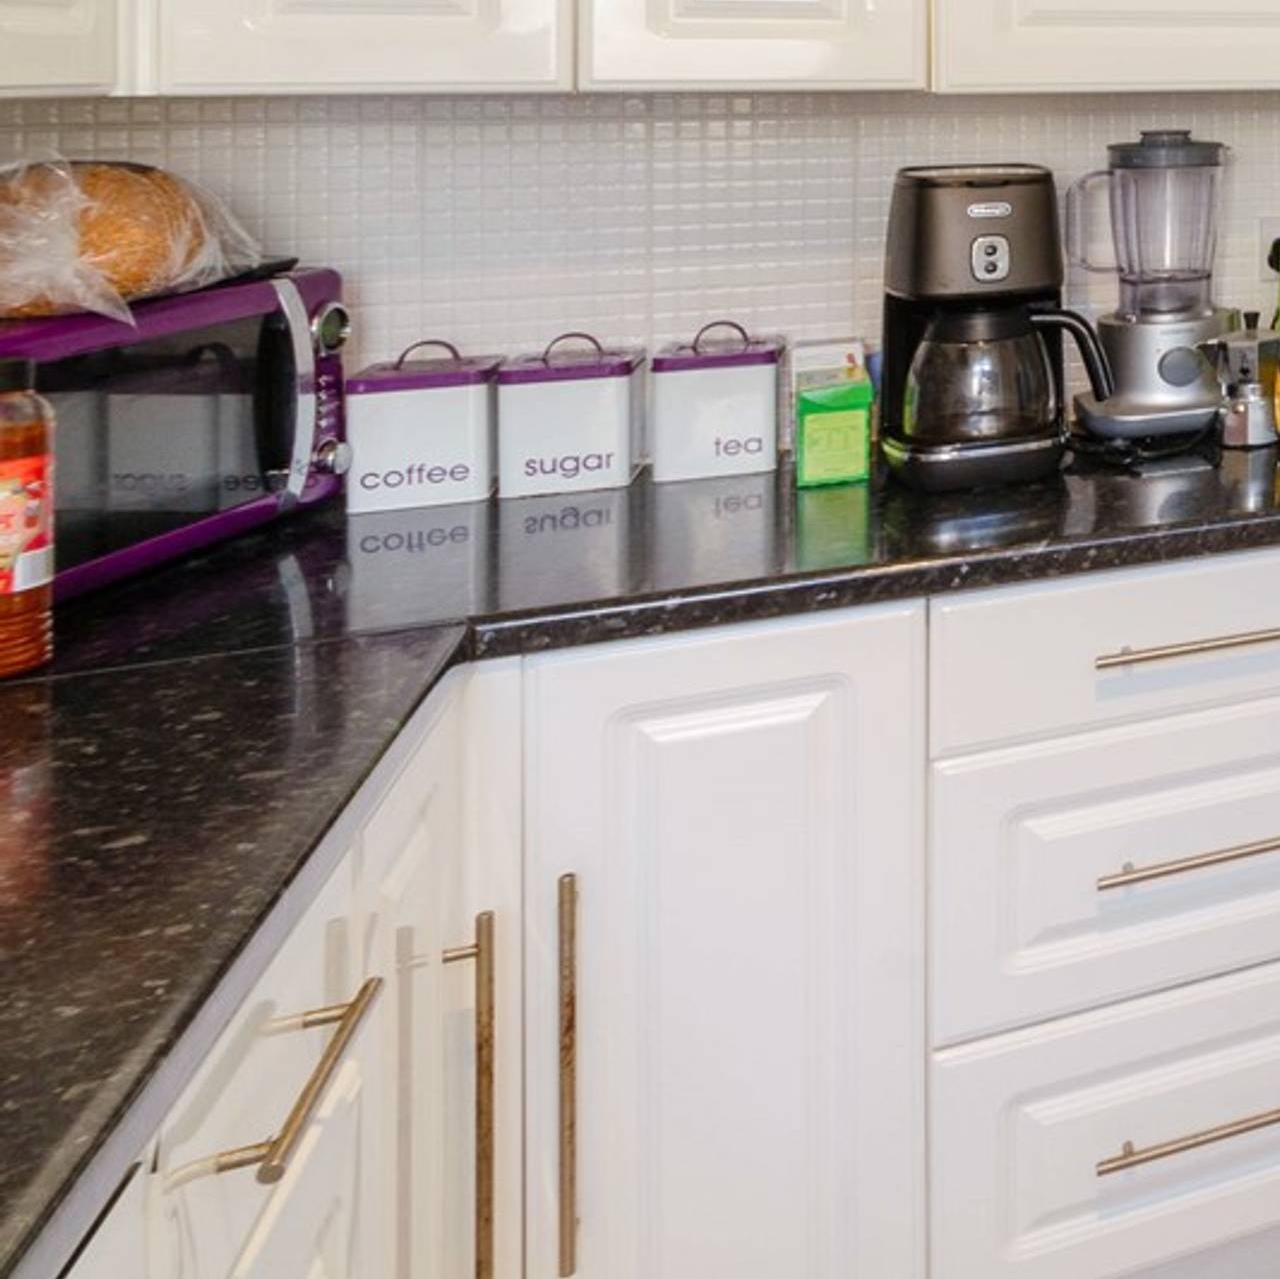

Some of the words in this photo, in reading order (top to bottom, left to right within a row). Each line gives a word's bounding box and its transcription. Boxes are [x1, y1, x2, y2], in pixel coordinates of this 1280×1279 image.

[714, 436, 763, 458] tea
[359, 463, 470, 490] coffee
[524, 452, 614, 479] sugar
